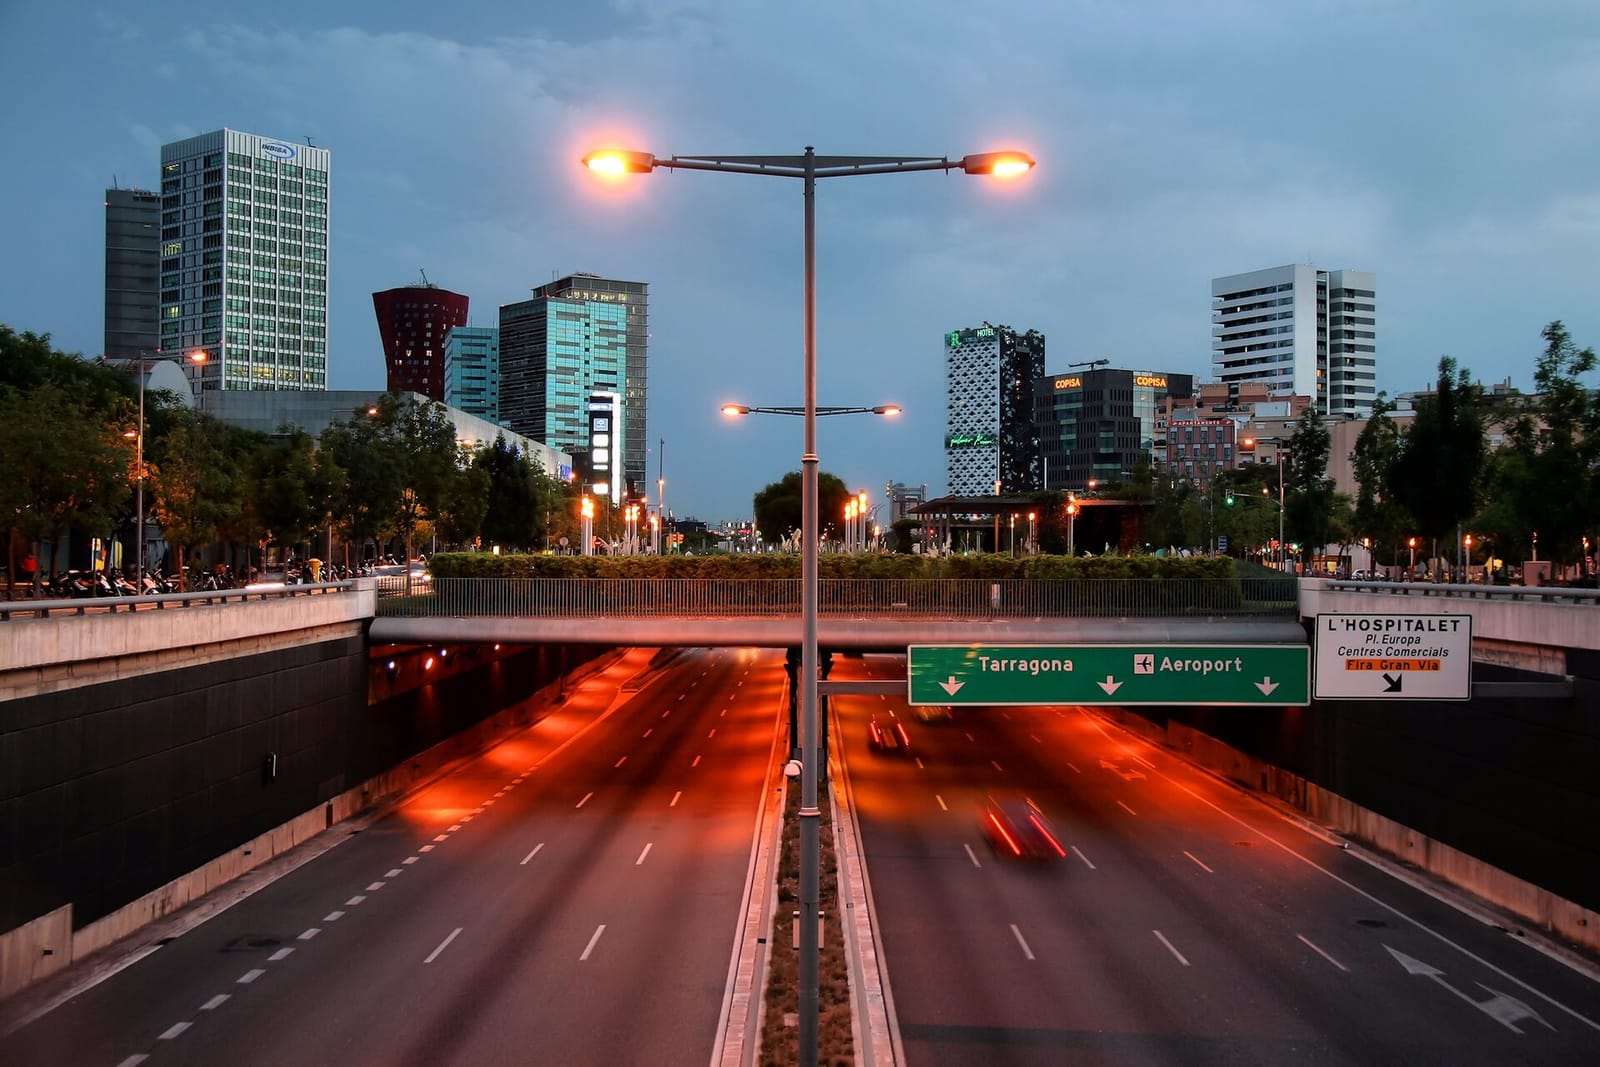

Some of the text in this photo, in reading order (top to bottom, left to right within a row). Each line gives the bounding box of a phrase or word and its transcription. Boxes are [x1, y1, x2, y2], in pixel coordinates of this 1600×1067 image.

[977, 329, 994, 337] HOTEL
[1055, 377, 1081, 389] COPISA
[1137, 376, 1167, 388] COPISA
[1328, 618, 1461, 632] L'HOSPITALET
[1365, 634, 1421, 647] Pl. Europa
[1337, 646, 1449, 658] Centres Comercials
[978, 656, 1242, 675] Tarragona Aeroport
[1347, 660, 1439, 670] Fira Gran Via
